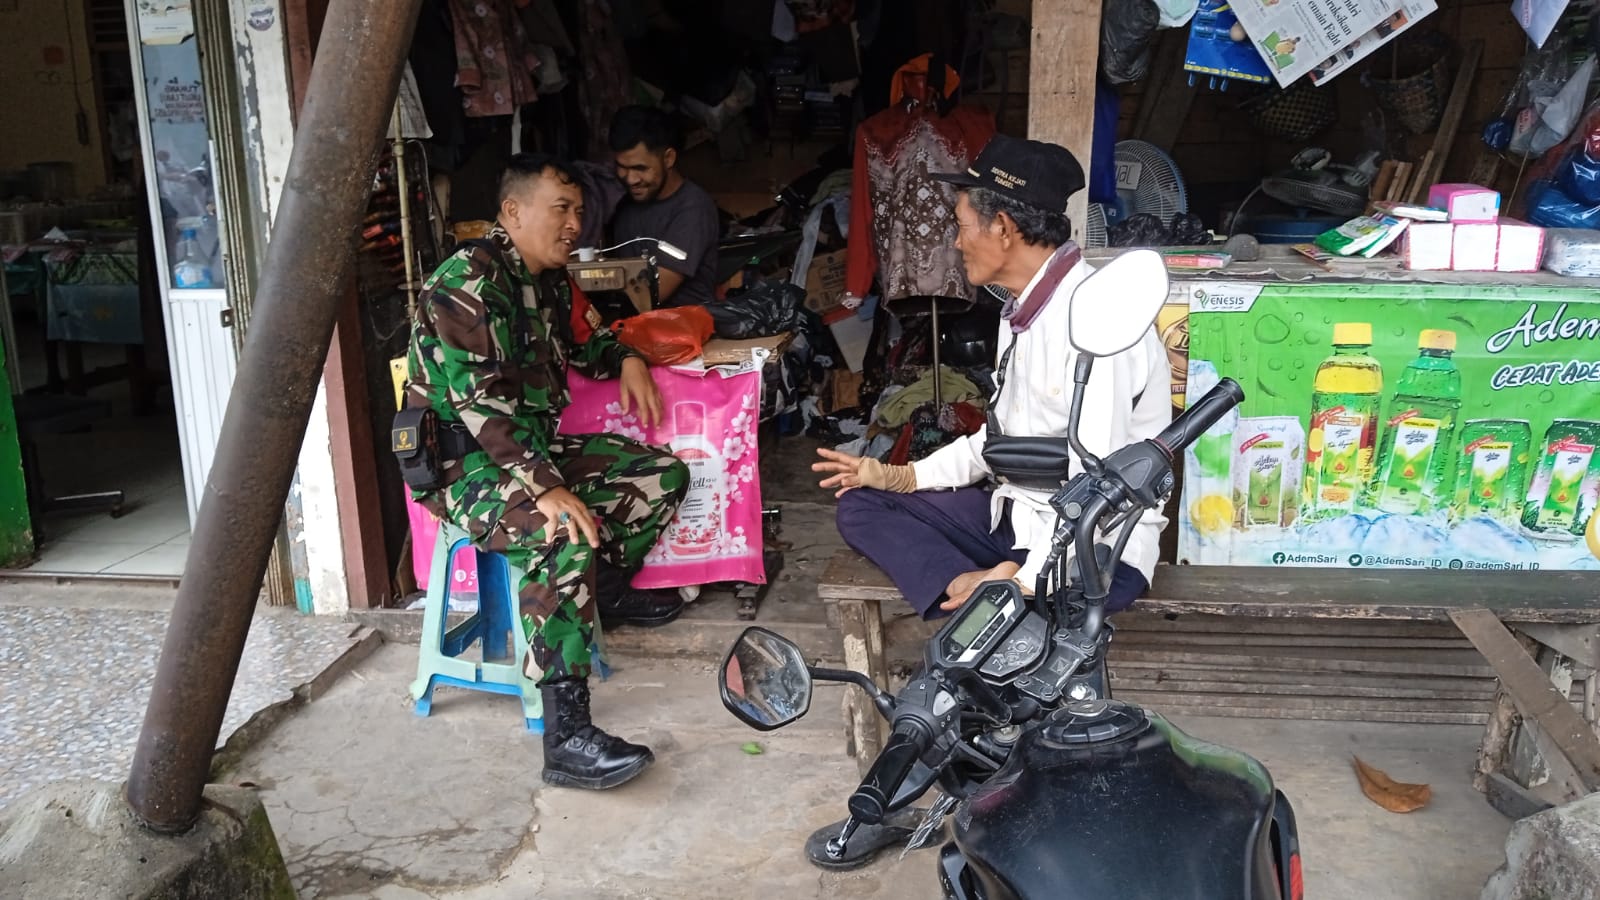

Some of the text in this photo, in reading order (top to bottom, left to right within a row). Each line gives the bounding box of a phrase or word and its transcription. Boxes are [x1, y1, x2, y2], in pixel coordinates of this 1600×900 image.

[1323, 23, 1342, 46] Fight
[1491, 359, 1600, 389] CEPAT ADE
[1286, 554, 1338, 564] AdemSari
[1465, 560, 1540, 571] @ademSariID
